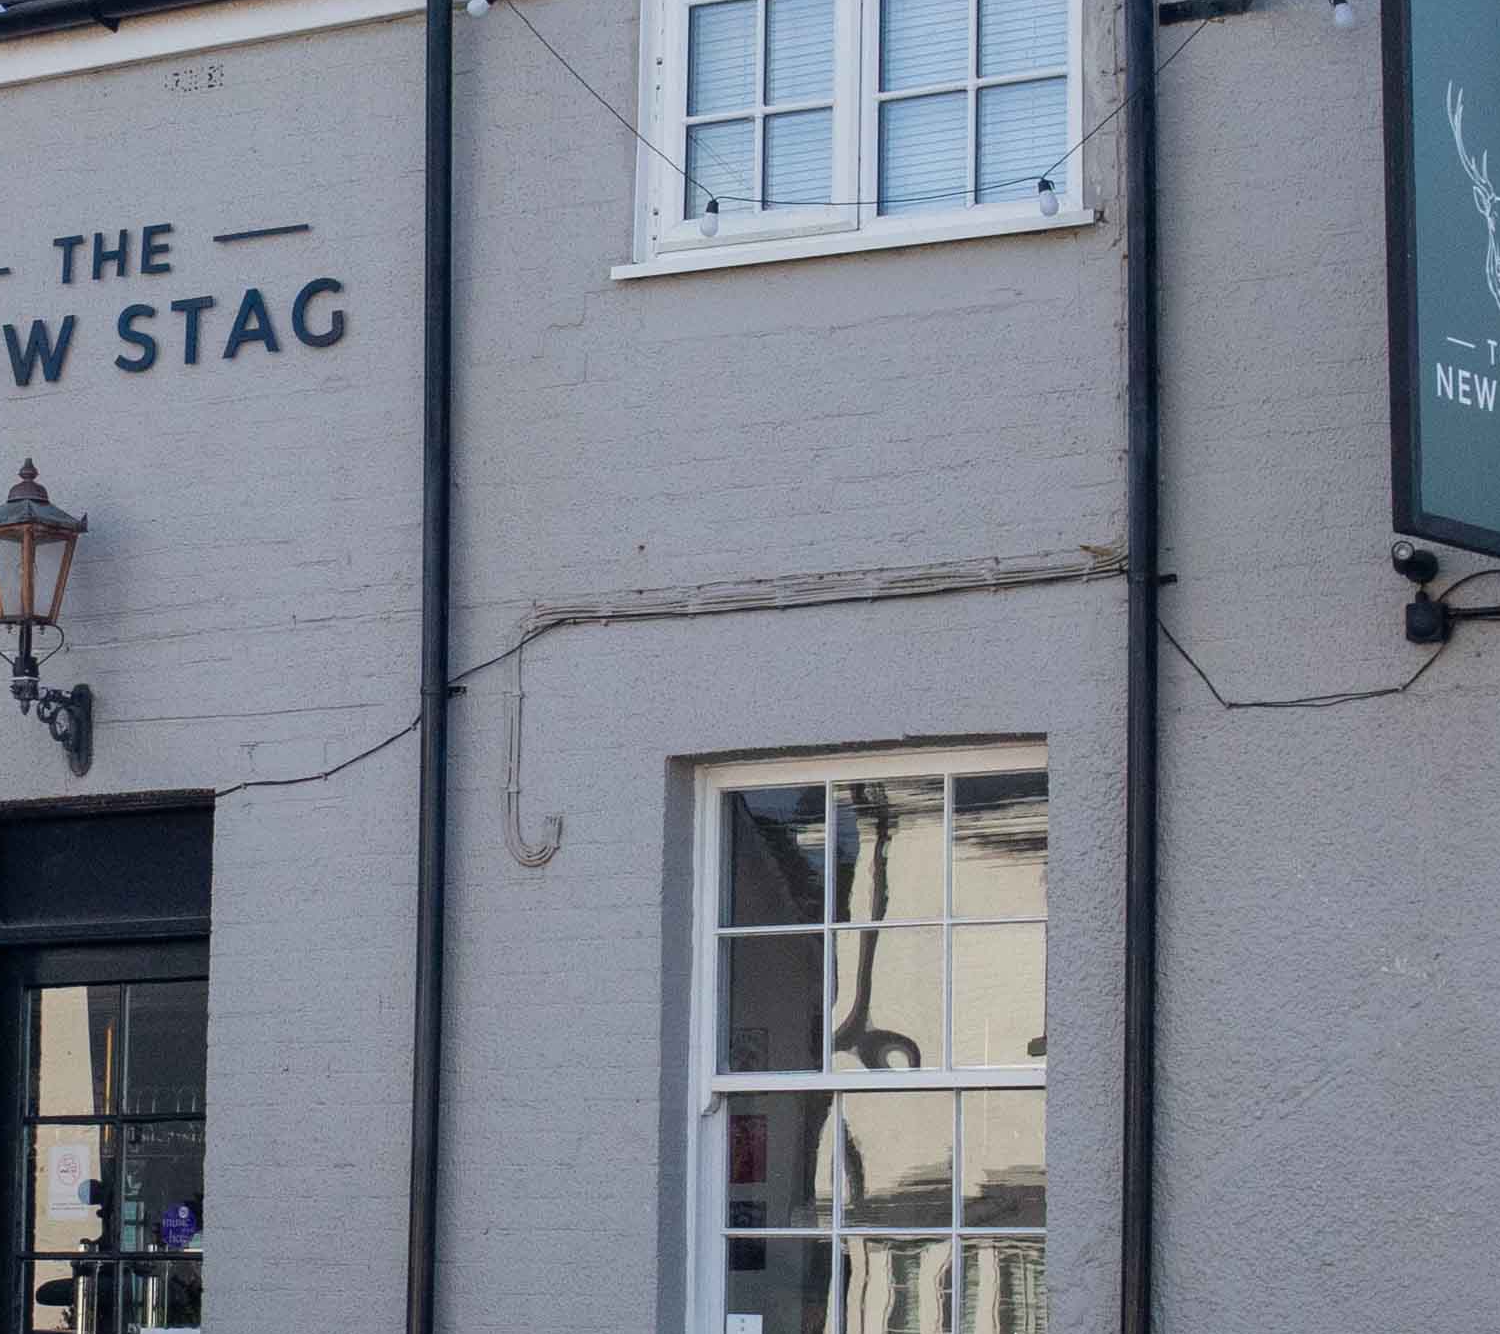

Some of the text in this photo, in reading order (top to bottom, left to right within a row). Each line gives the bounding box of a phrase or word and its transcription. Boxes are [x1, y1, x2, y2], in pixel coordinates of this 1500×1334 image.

[53, 223, 172, 284] THE
[114, 277, 346, 373] STAG
[1436, 362, 1497, 412] NEW
